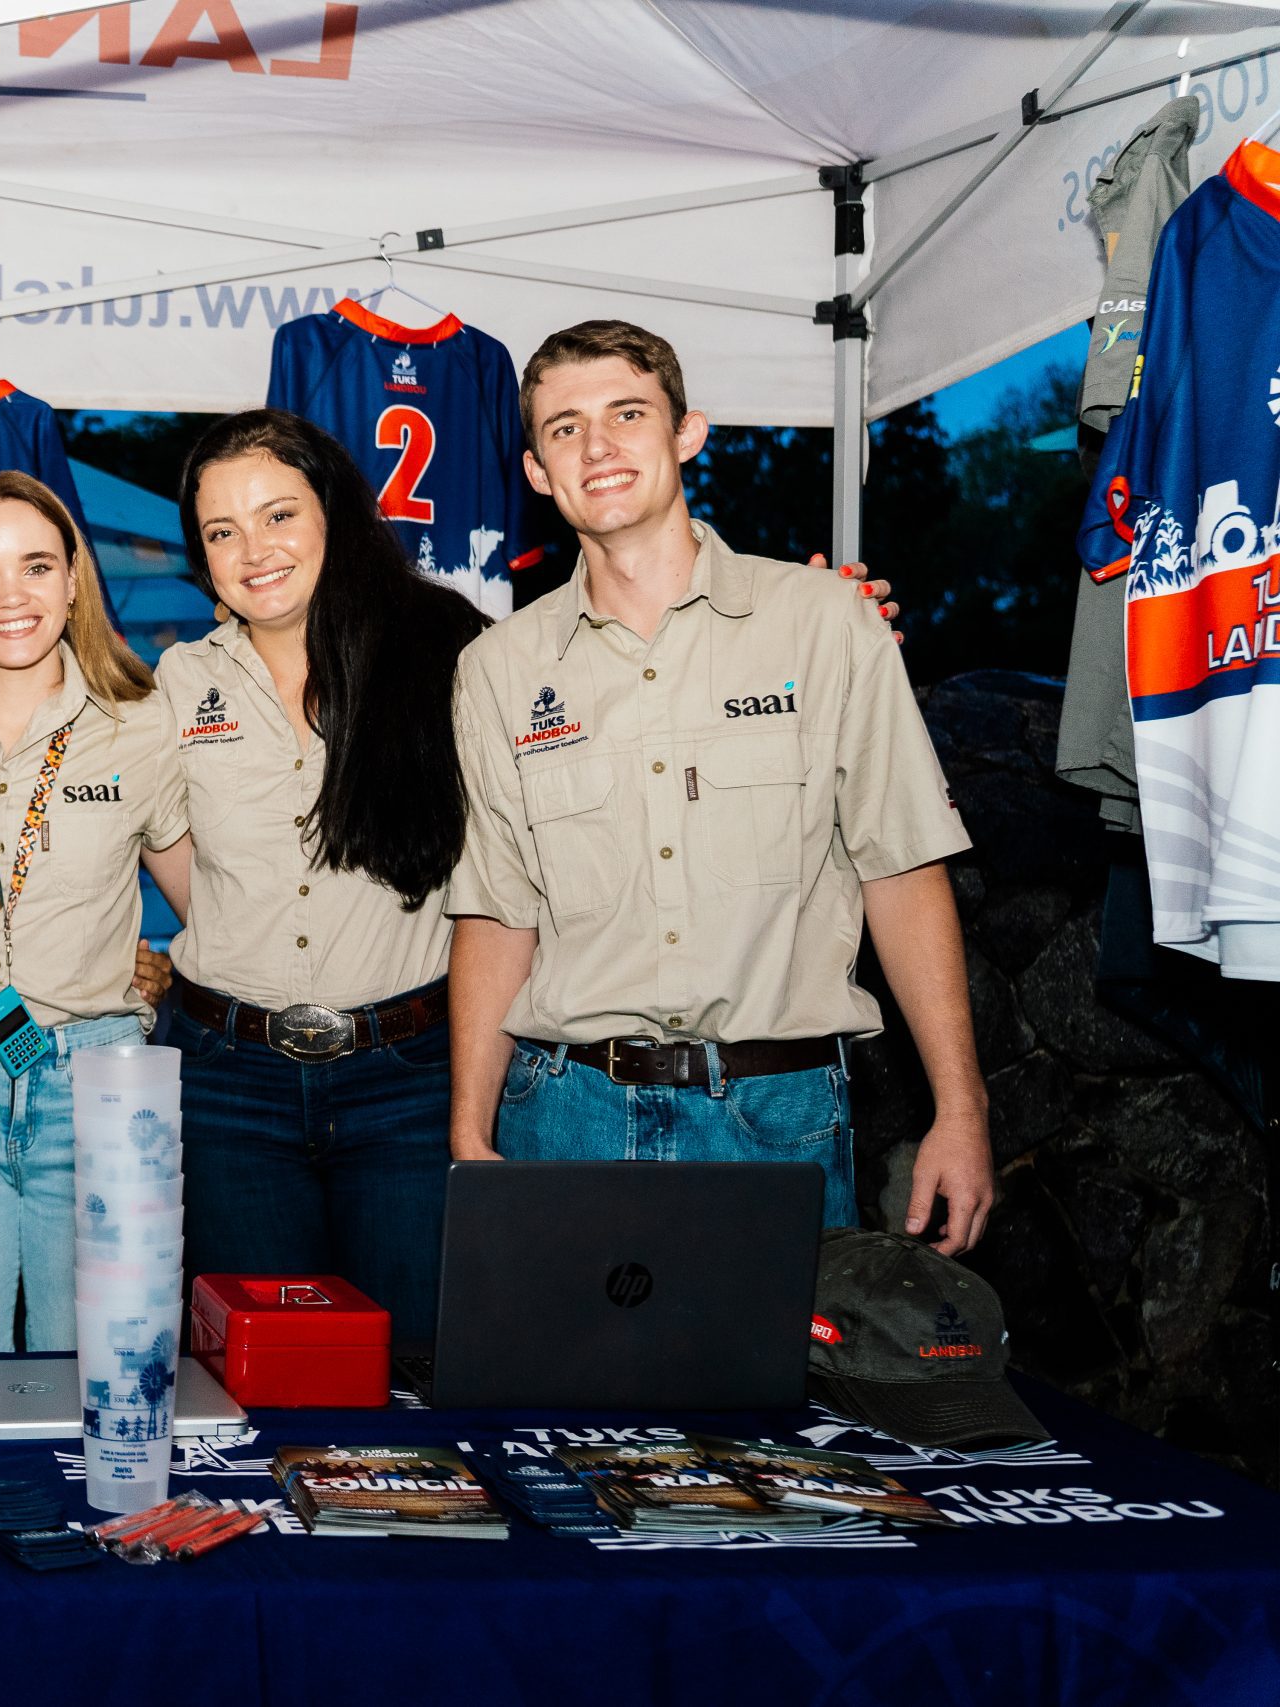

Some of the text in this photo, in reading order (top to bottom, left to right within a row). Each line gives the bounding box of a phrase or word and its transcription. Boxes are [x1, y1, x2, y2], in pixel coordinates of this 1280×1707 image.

[1100, 299, 1147, 314] CAS
[392, 374, 417, 386] TUKS
[375, 404, 436, 524] 2
[723, 681, 799, 719] saai
[195, 713, 226, 726] TUKS
[530, 715, 566, 732] TUKS
[182, 721, 239, 738] LANDBOU
[515, 721, 581, 747] LANDBOU
[63, 773, 123, 805] saai
[611, 1262, 649, 1308] hp
[513, 1427, 687, 1442] TUKS
[303, 1478, 482, 1491] COUNCIL
[649, 1473, 734, 1487] RAA
[772, 1477, 888, 1497] RAAD
[921, 1485, 1113, 1507] TUKS
